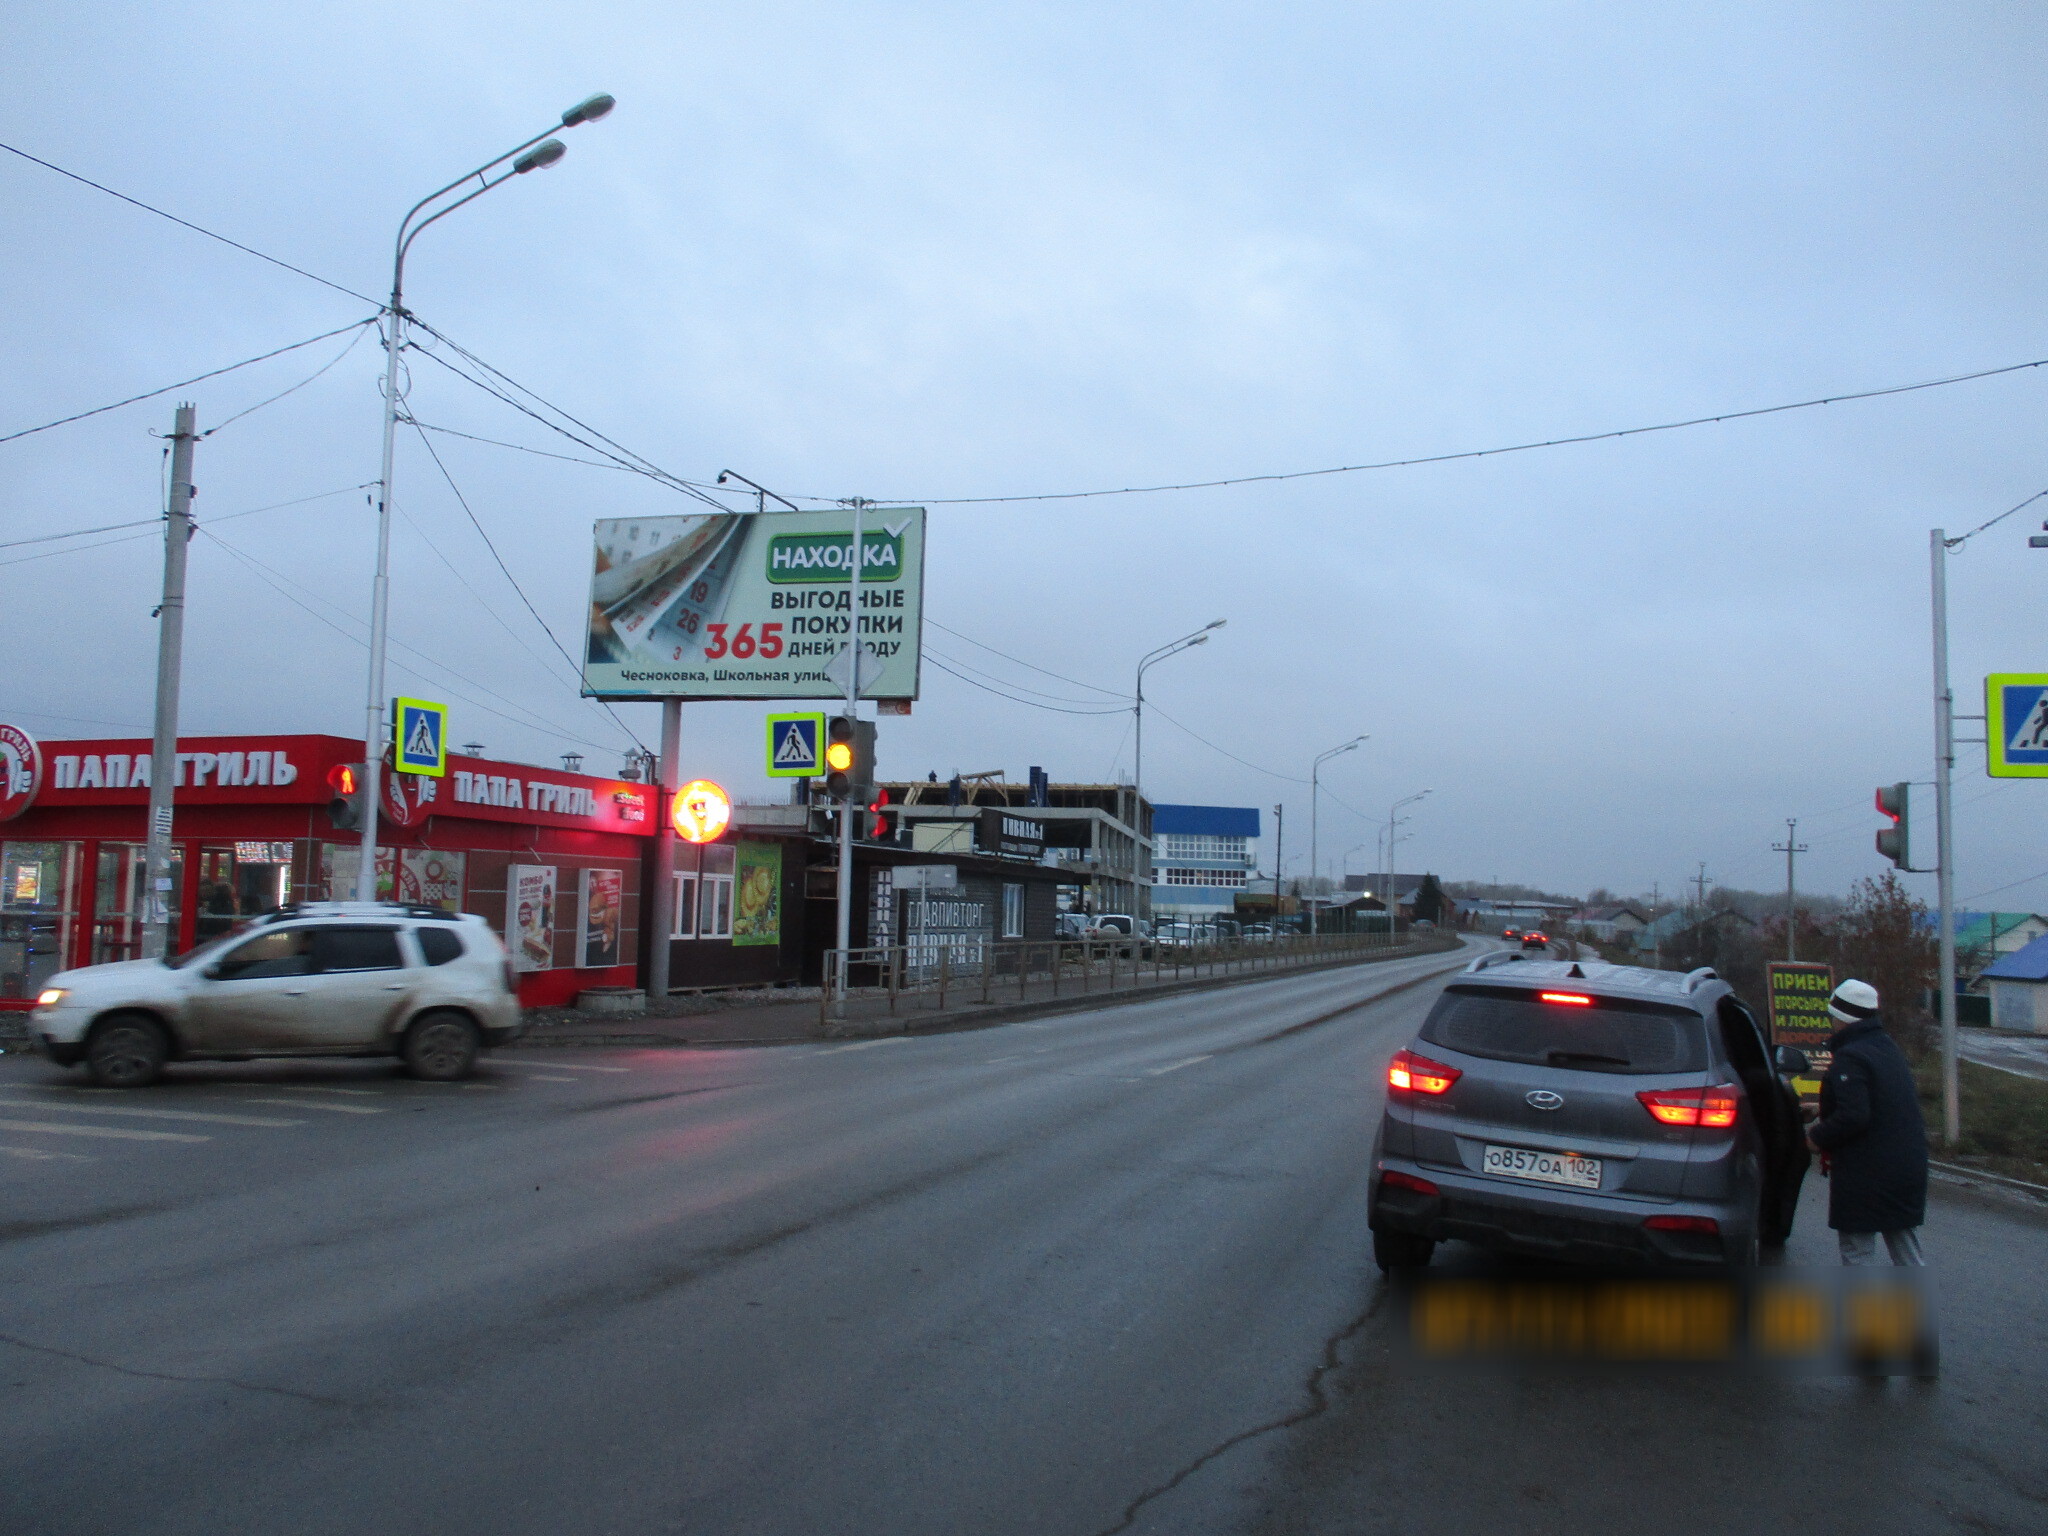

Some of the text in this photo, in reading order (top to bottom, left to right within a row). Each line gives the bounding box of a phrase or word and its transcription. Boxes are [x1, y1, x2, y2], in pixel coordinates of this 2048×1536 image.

[772, 543, 897, 570] НАХОДКА
[771, 589, 904, 612] ВЫГОДНЫЕ
[676, 607, 700, 635] 26
[792, 616, 903, 635] ПОКУПКИ
[704, 623, 783, 659] 365
[788, 638, 835, 658] ДНЕЙ
[672, 646, 682, 660] 3
[621, 669, 831, 684] Чесноковка, Школьная улиц
[54, 750, 297, 789] ПАПА ГРИЛЬ
[453, 770, 598, 817] ПАПА ГРИЛЬ
[908, 901, 985, 928] ГЛАВПИВТОРГ
[1773, 973, 1830, 991] ПРИЕМ
[1775, 1014, 1833, 1029] И ЛОМА
[1567, 1158, 1595, 1176] 102
